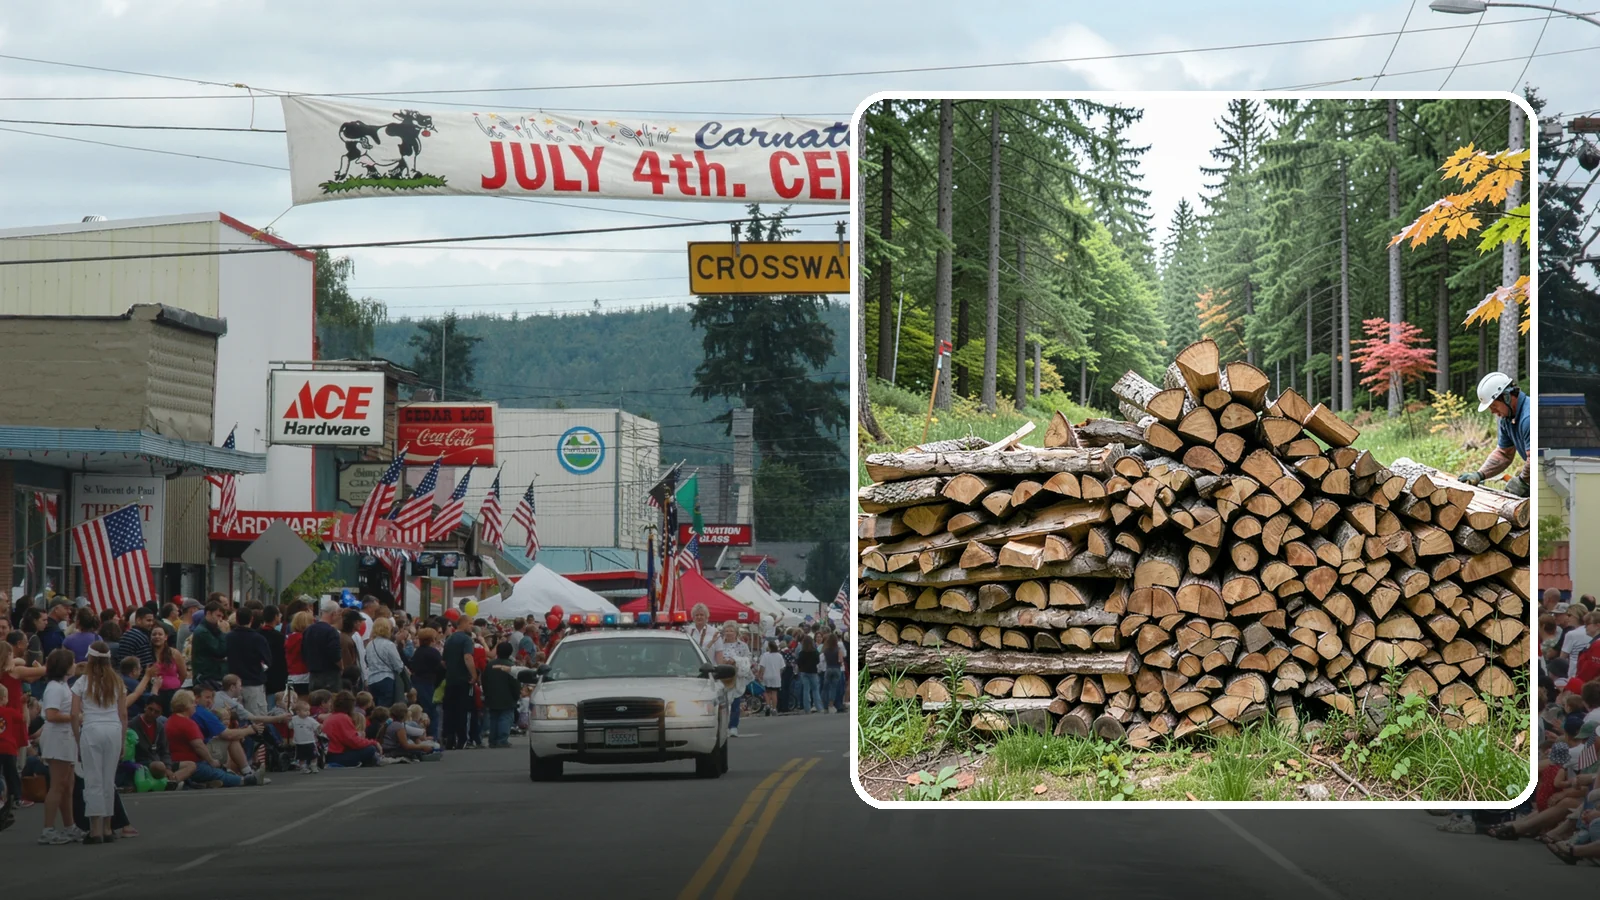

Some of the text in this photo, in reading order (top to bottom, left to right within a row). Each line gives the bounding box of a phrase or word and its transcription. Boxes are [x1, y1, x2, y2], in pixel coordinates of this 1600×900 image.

[695, 121, 850, 149] Carnat
[481, 141, 604, 193] JULY
[632, 150, 746, 198] 4th.
[697, 254, 850, 280] CROSSWA
[283, 380, 373, 420] ACE
[405, 409, 452, 422] CEDAR
[283, 421, 370, 436] Hardware
[416, 428, 477, 447] Coca-Cola
[353, 467, 385, 480] Simpl
[96, 485, 124, 495] Vincent
[126, 486, 136, 495] de
[137, 486, 155, 495] Paul
[688, 526, 741, 535] CRNATION
[699, 535, 730, 543] GLASS
